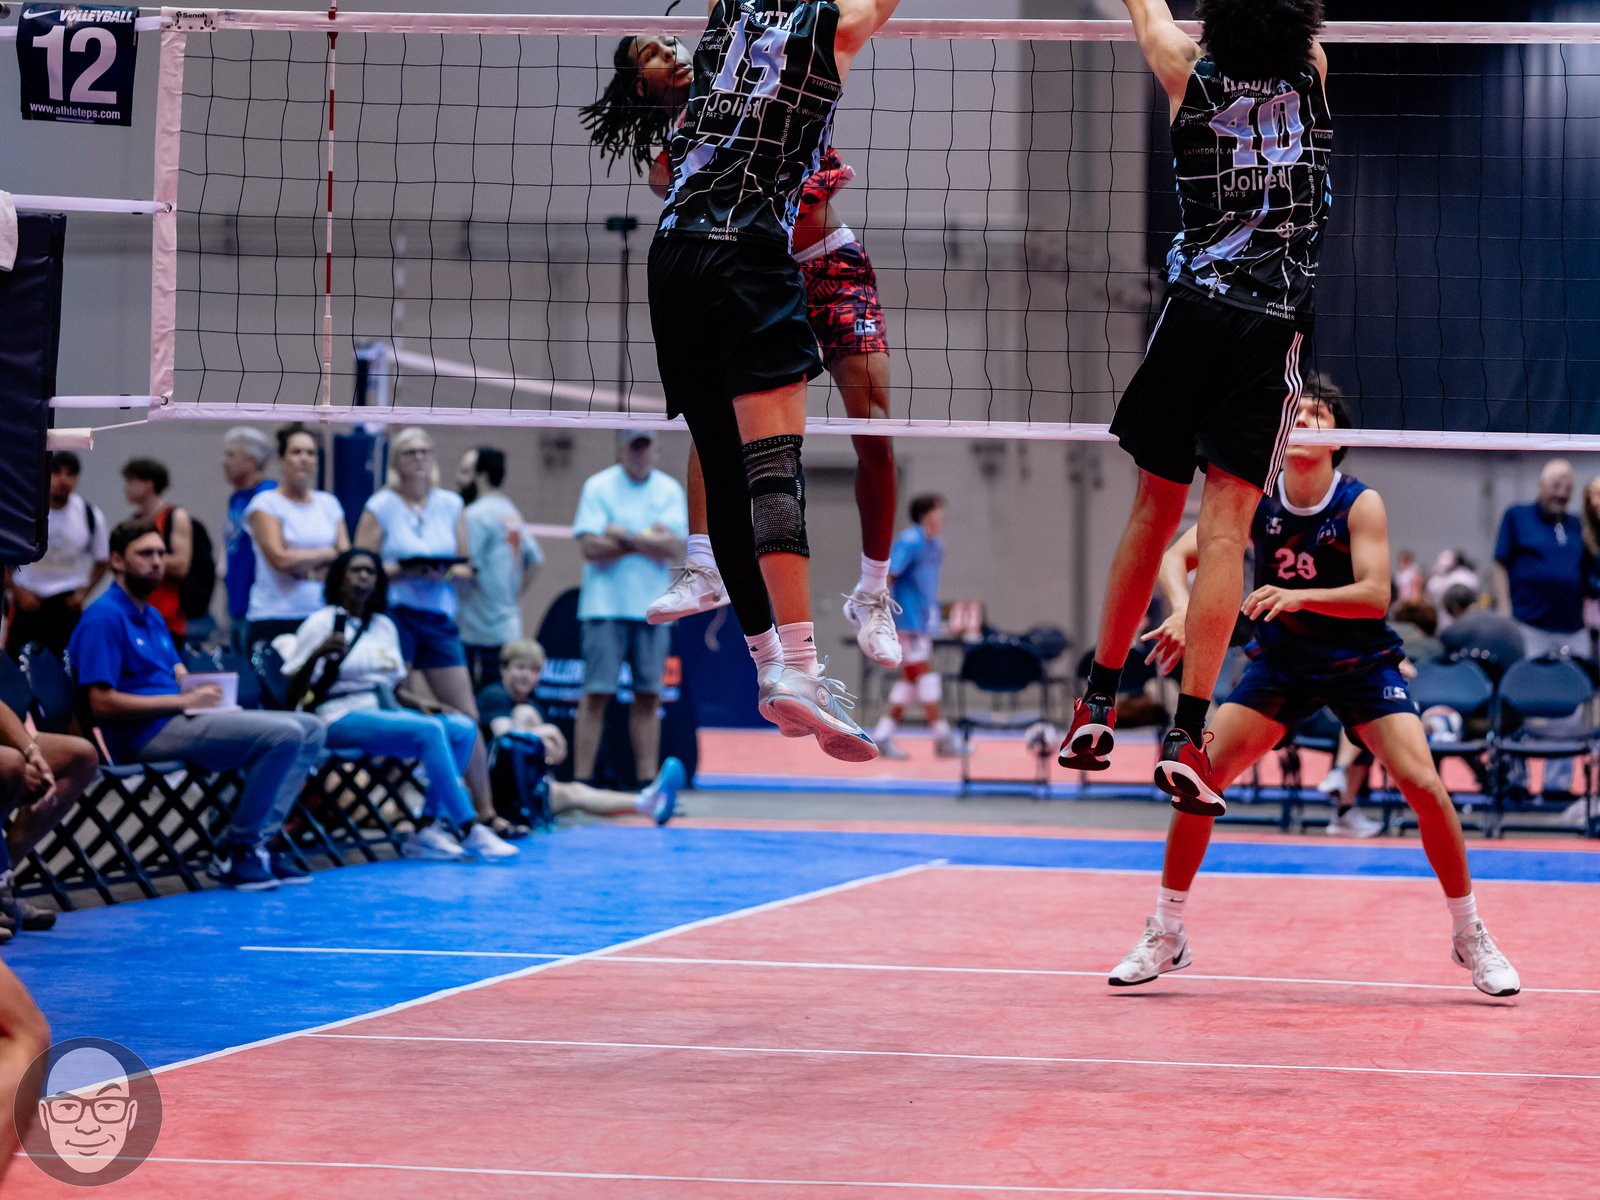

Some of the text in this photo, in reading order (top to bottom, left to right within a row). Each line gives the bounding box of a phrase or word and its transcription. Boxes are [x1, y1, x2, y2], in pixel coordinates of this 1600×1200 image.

[60, 9, 132, 23] VOLLEYBALL
[32, 25, 117, 104] 12
[712, 12, 791, 99] 14
[30, 103, 120, 120] www.athleteps.com
[706, 111, 724, 120] PAT'S
[708, 93, 760, 118] Joliet
[1209, 90, 1304, 168] 40
[1223, 169, 1286, 191] Joliet
[1275, 547, 1317, 581] 29
